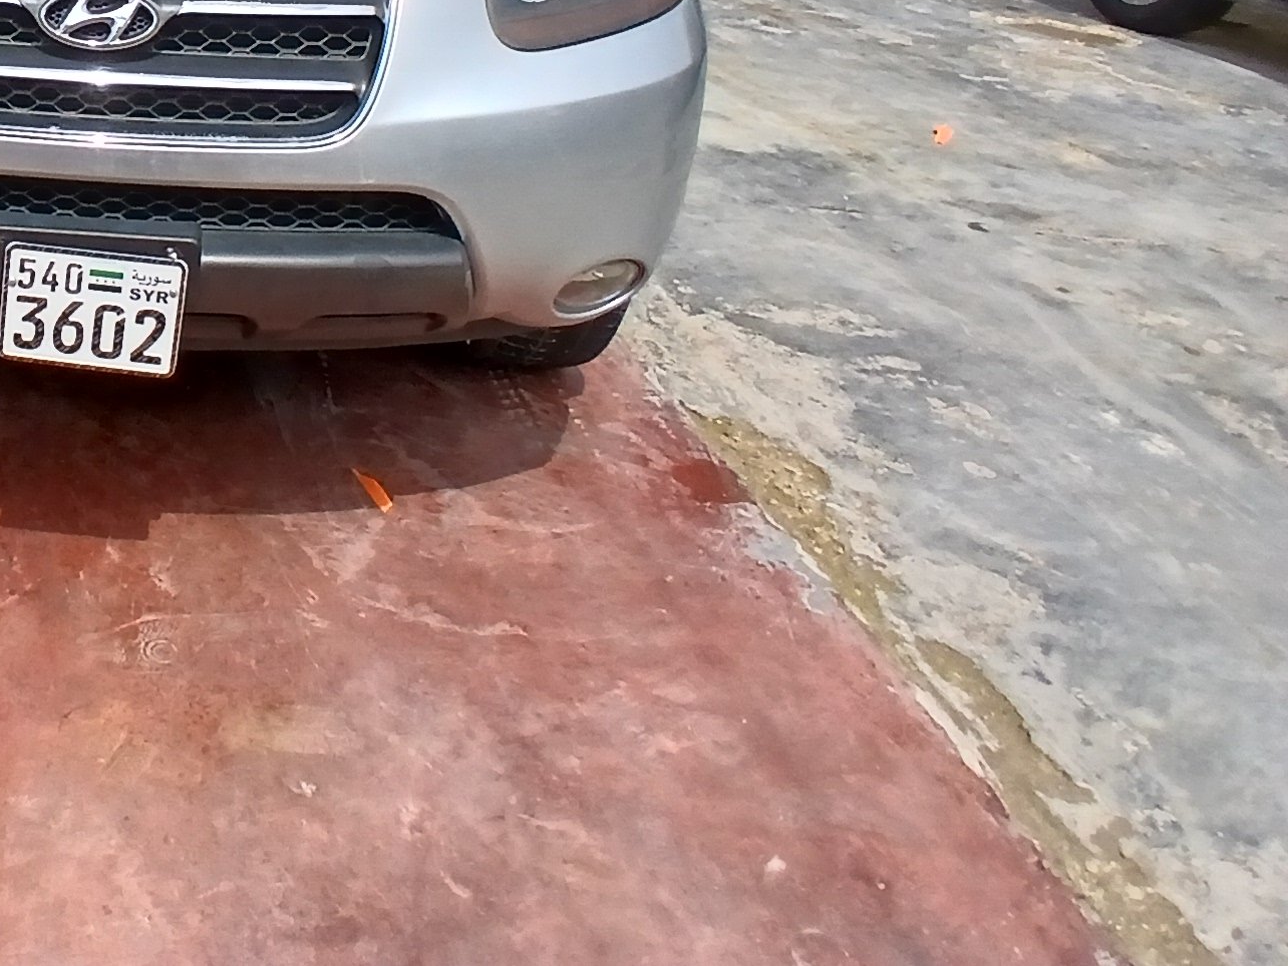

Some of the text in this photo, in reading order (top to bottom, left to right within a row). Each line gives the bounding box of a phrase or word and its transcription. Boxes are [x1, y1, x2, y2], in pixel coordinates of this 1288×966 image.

[17, 257, 83, 294] 540
[132, 269, 171, 286] سورية
[129, 288, 169, 304] SYR
[13, 295, 166, 365] 3602
